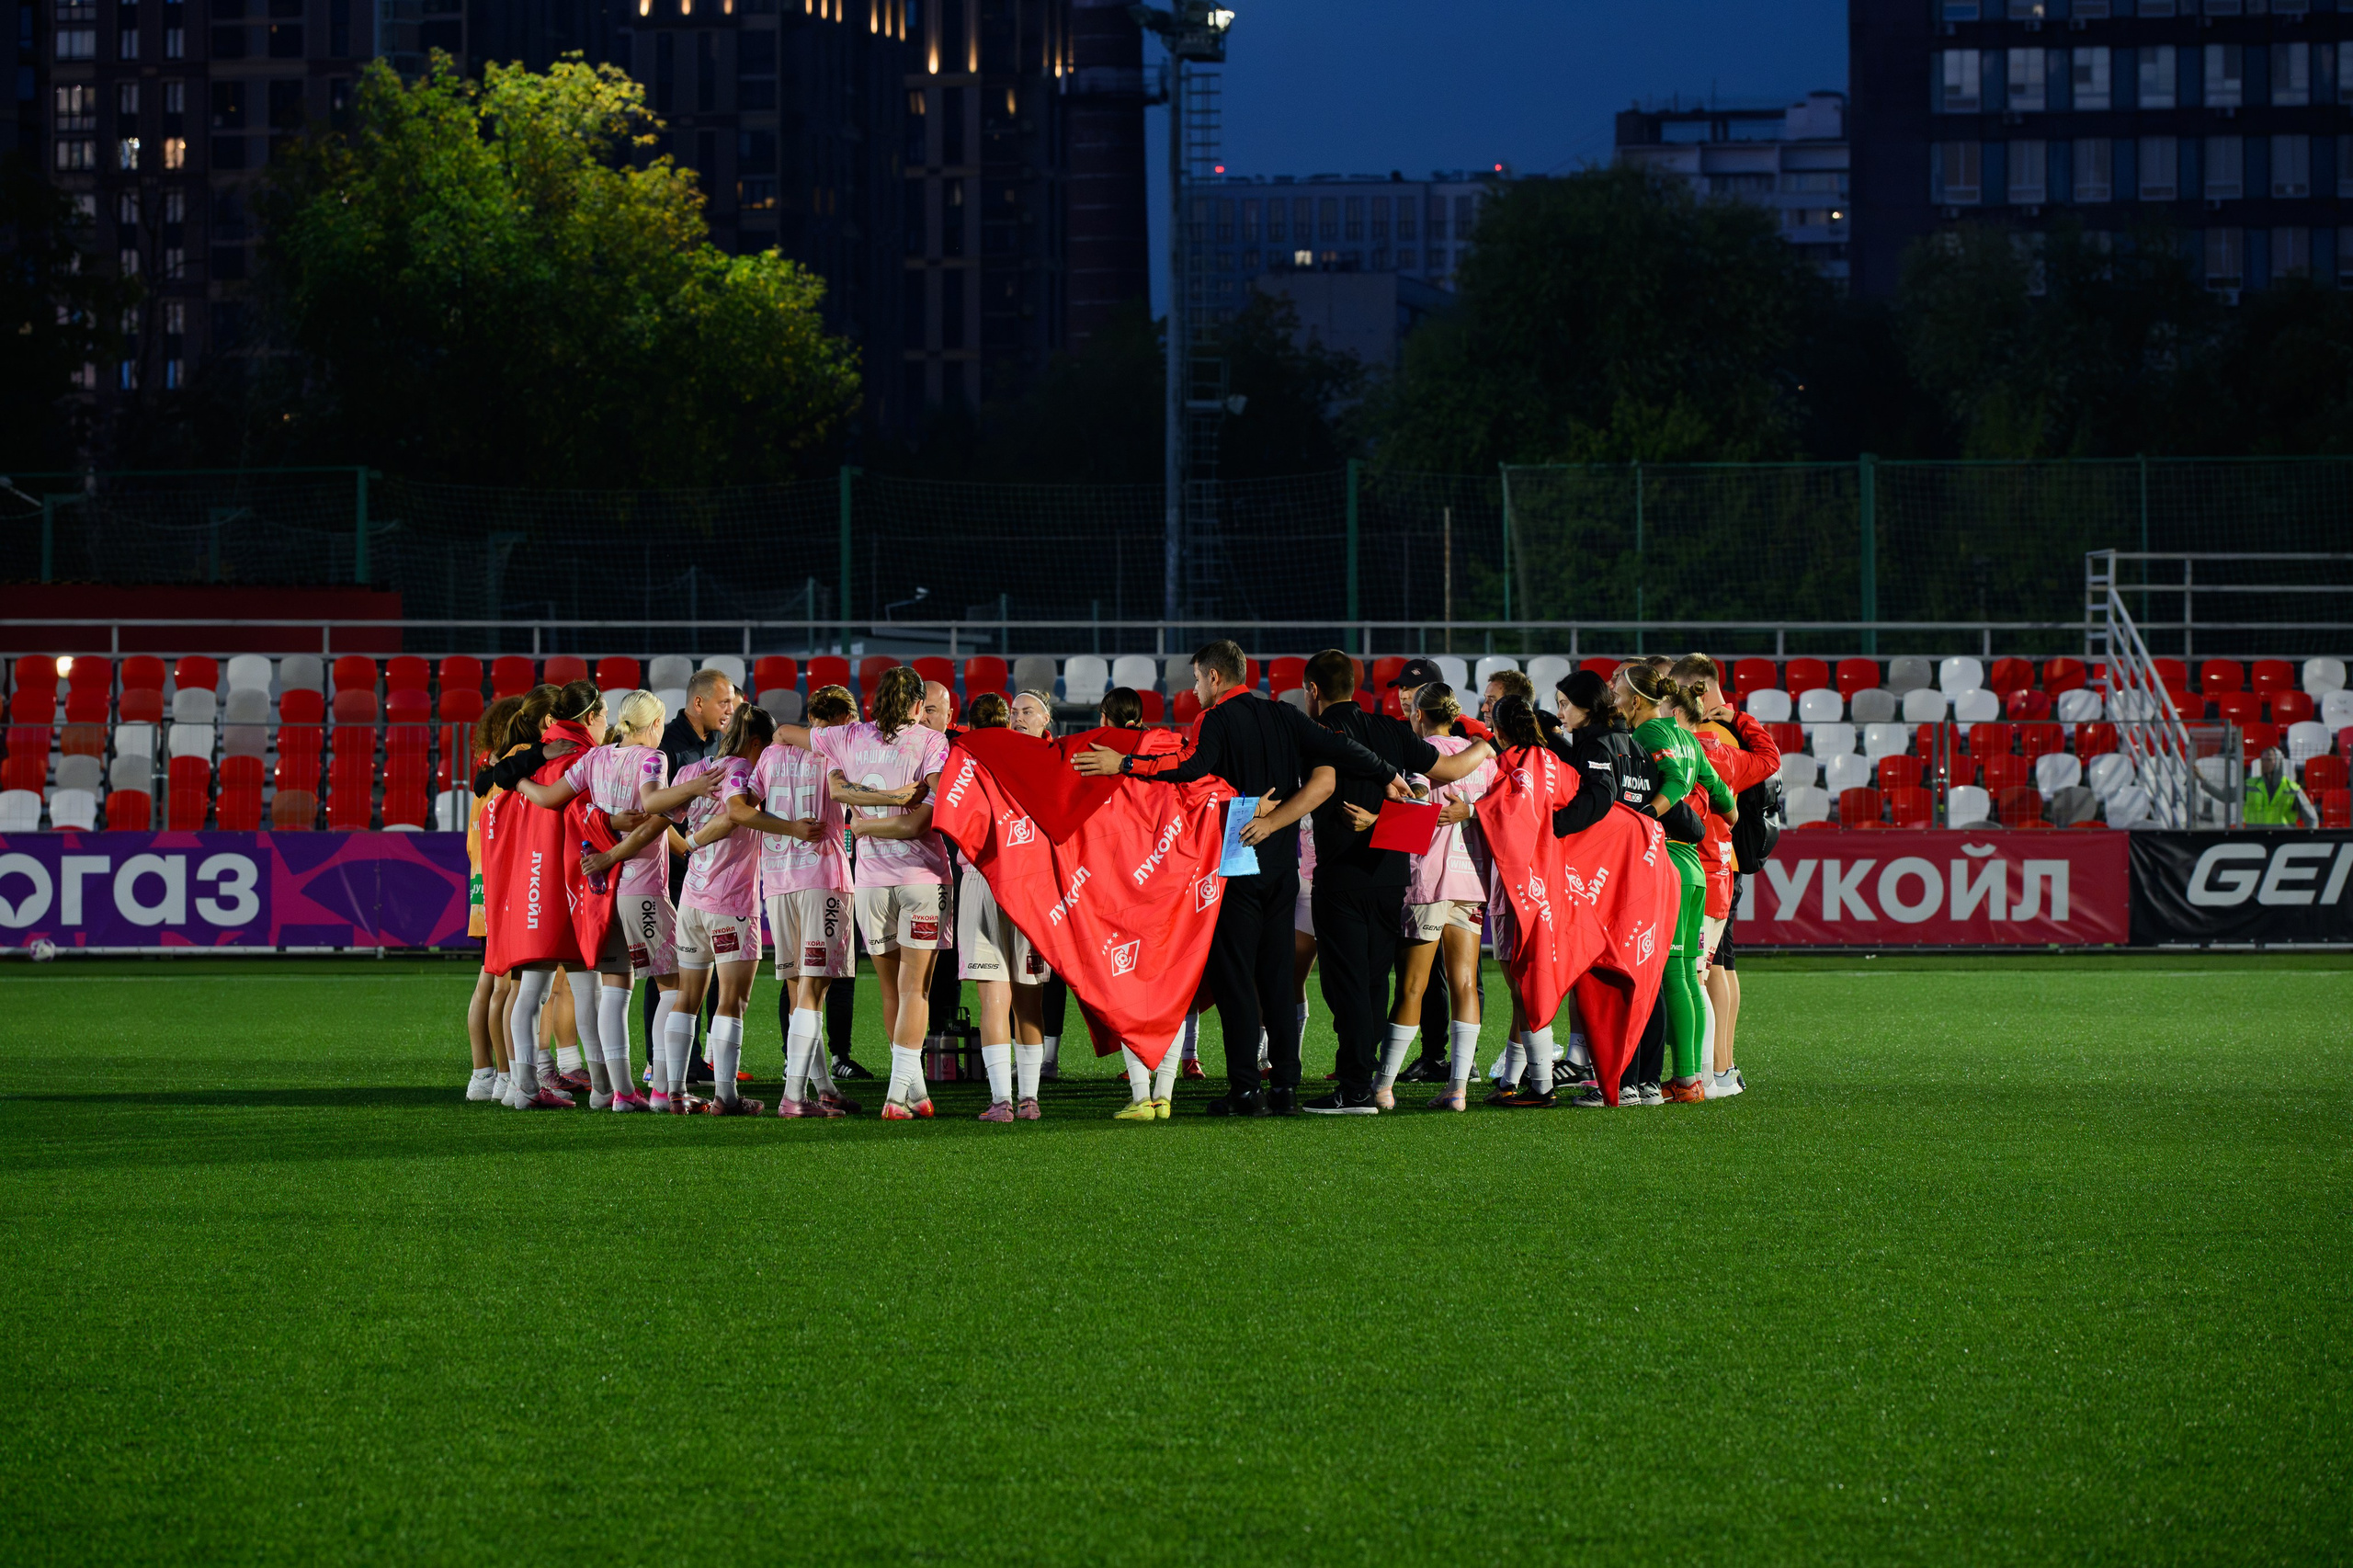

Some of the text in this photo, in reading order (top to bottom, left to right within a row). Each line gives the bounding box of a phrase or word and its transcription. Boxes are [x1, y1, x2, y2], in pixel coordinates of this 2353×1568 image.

[1133, 814, 1183, 886] ЛУКОЙЛ
[527, 851, 542, 929] ЛУКОЙЛ
[967, 962, 1000, 971] GENESIS
